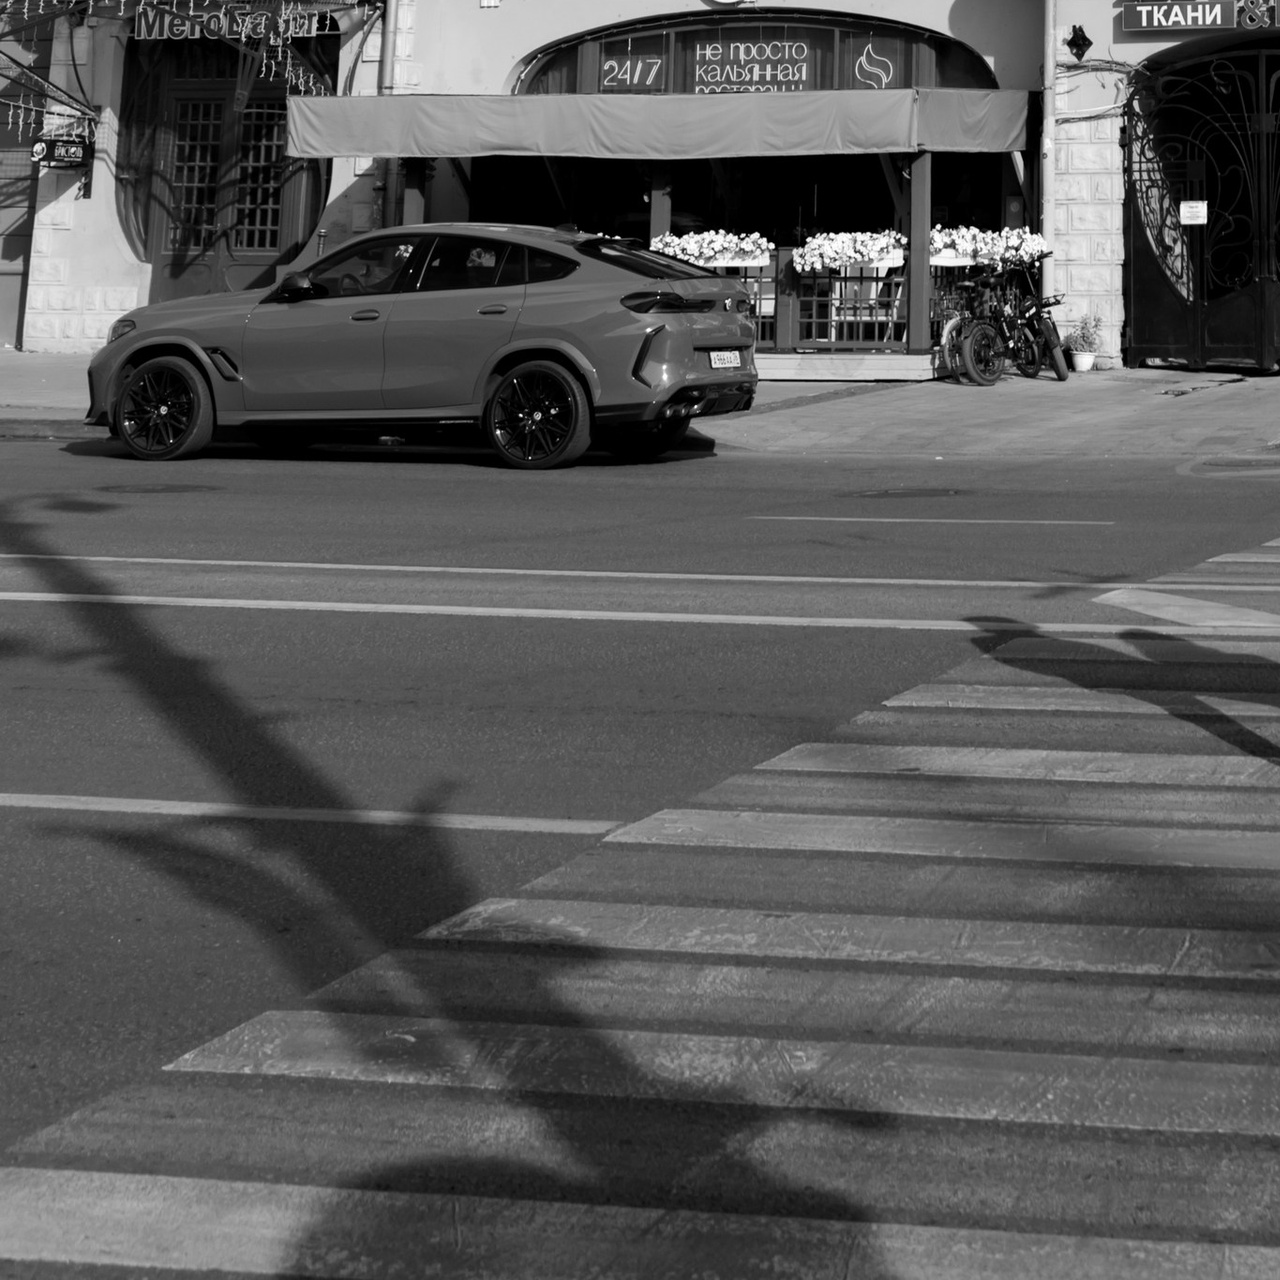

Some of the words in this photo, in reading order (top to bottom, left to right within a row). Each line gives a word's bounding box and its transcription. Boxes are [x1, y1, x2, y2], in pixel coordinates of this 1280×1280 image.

[1136, 4, 1222, 27] ТКАНИ
[697, 43, 722, 61] не
[730, 42, 807, 65] просто
[603, 59, 662, 86] 24/7
[696, 62, 807, 82] кальянная
